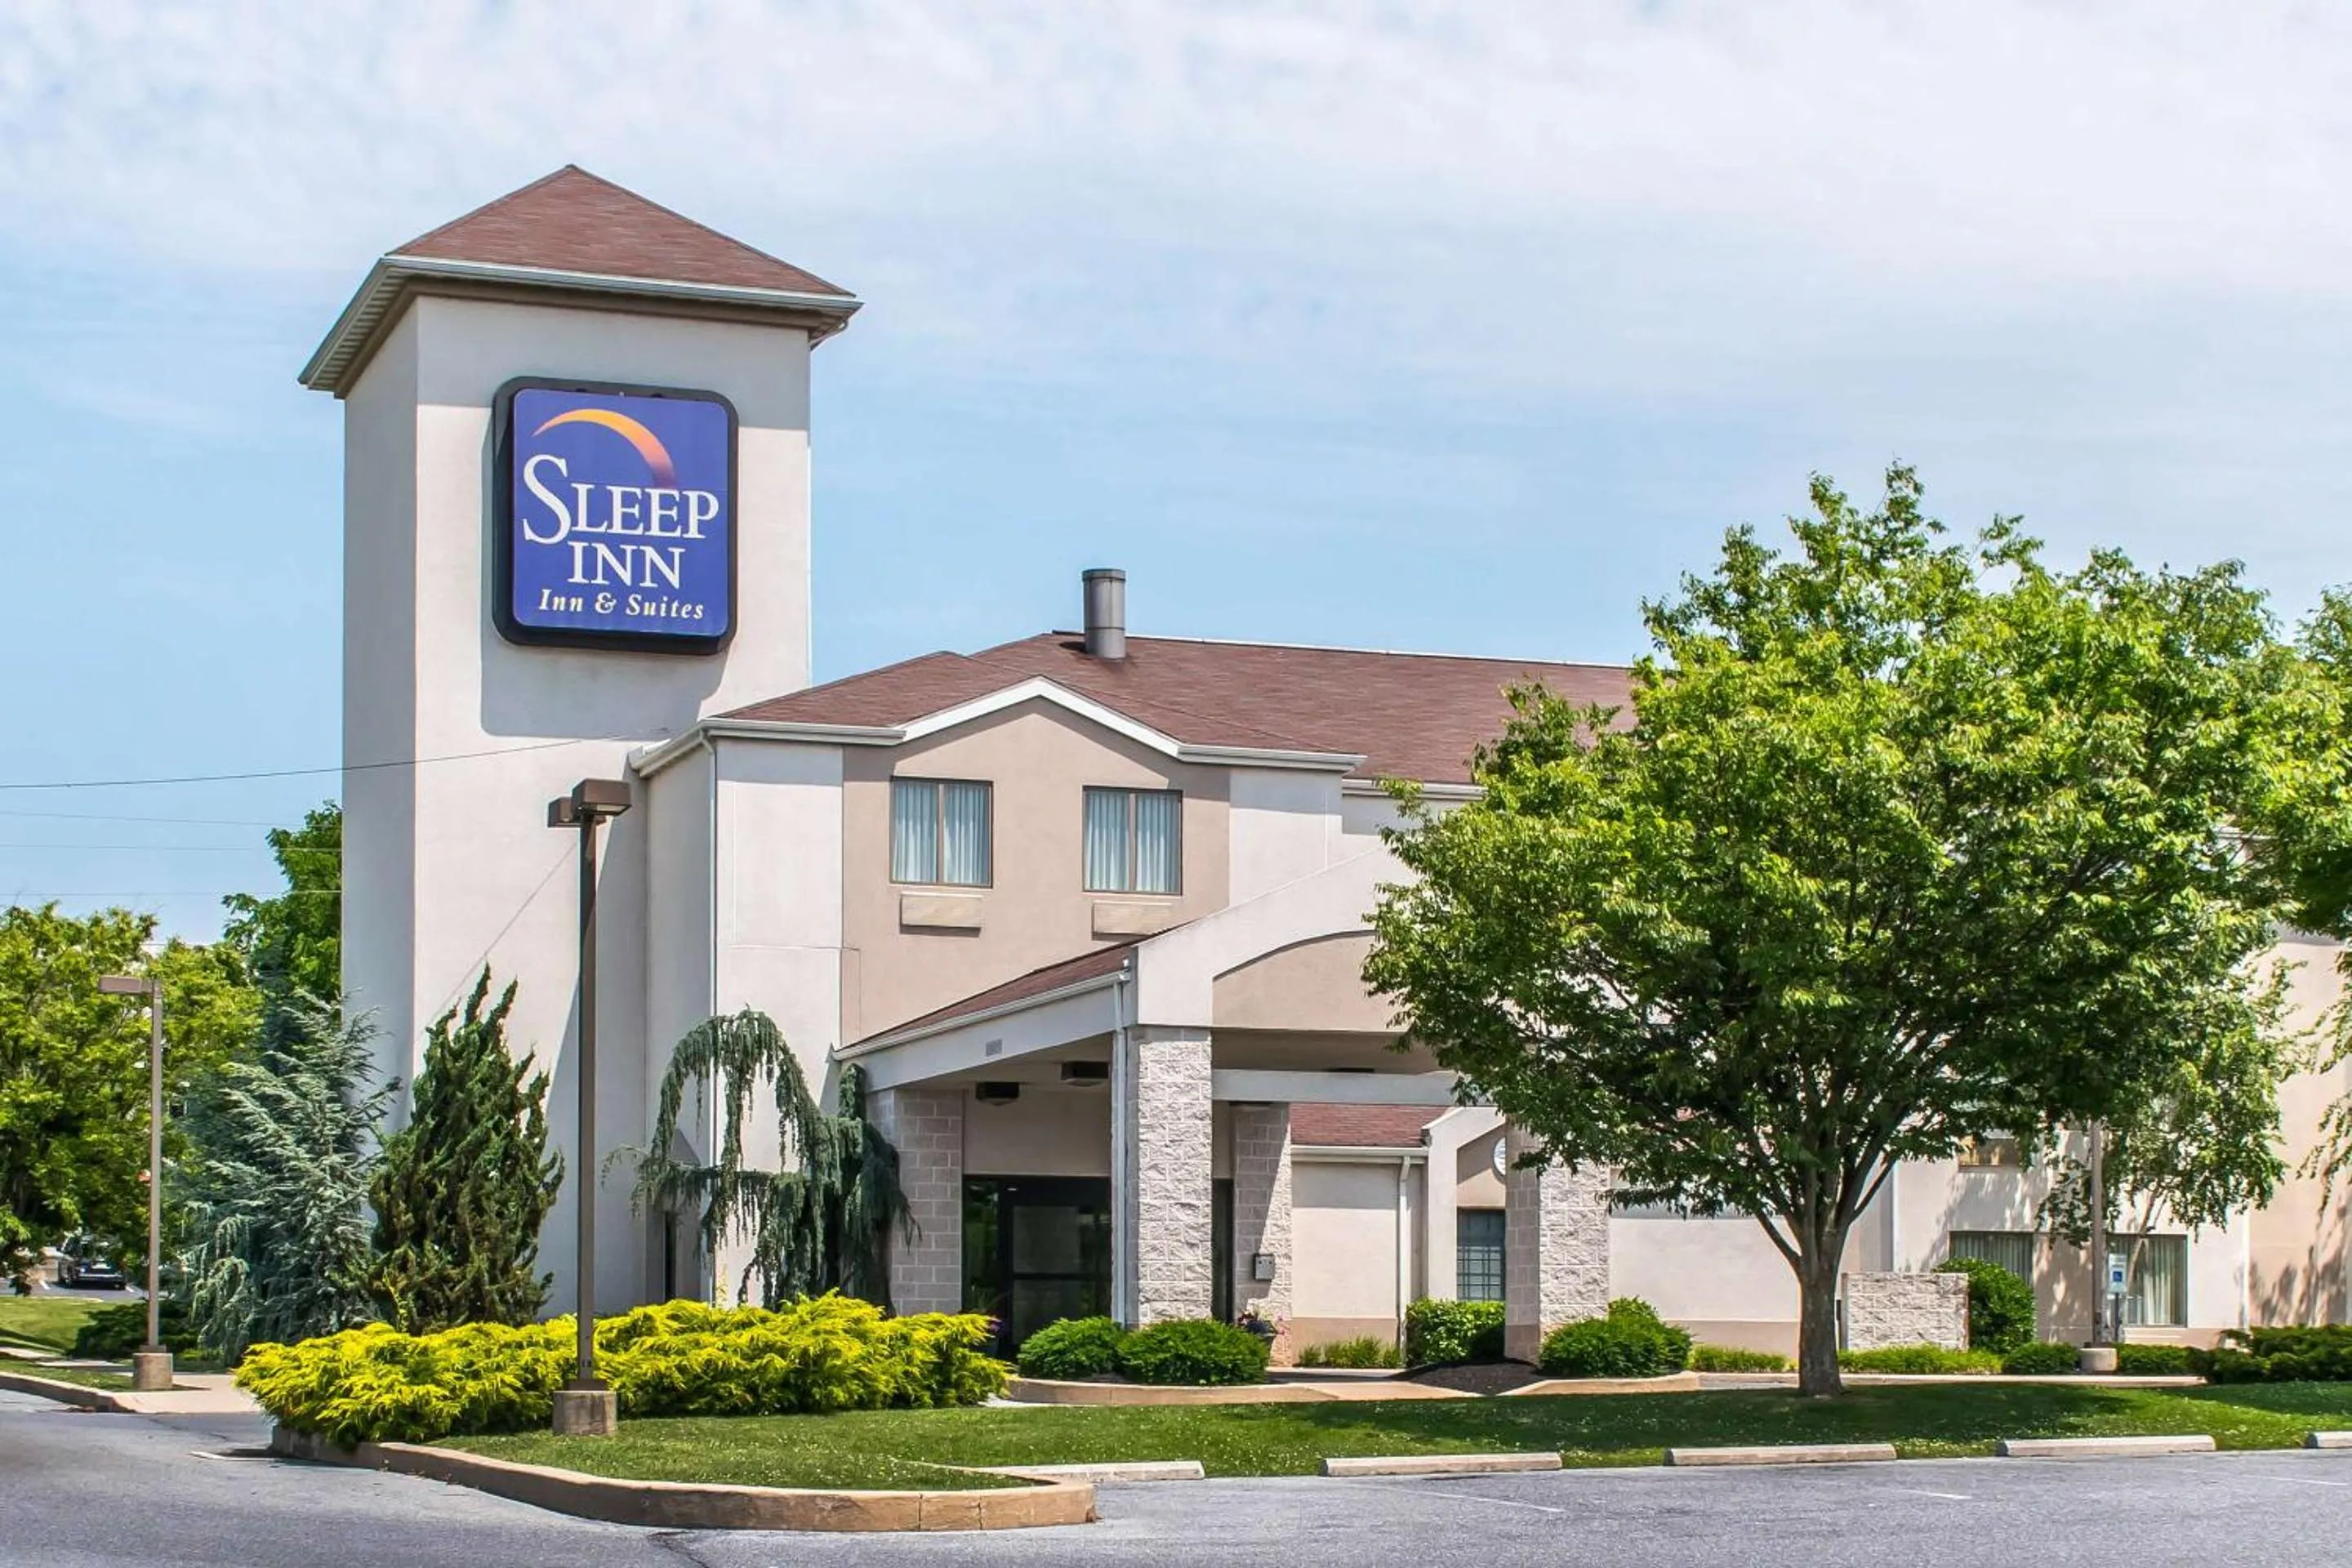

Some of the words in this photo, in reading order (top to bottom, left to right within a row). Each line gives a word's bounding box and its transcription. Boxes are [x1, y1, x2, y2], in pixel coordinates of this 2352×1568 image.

[523, 454, 719, 545] SLEEP
[568, 541, 686, 589] INN
[538, 589, 584, 612] Inn
[595, 592, 617, 614] &
[626, 594, 704, 619] Suites
